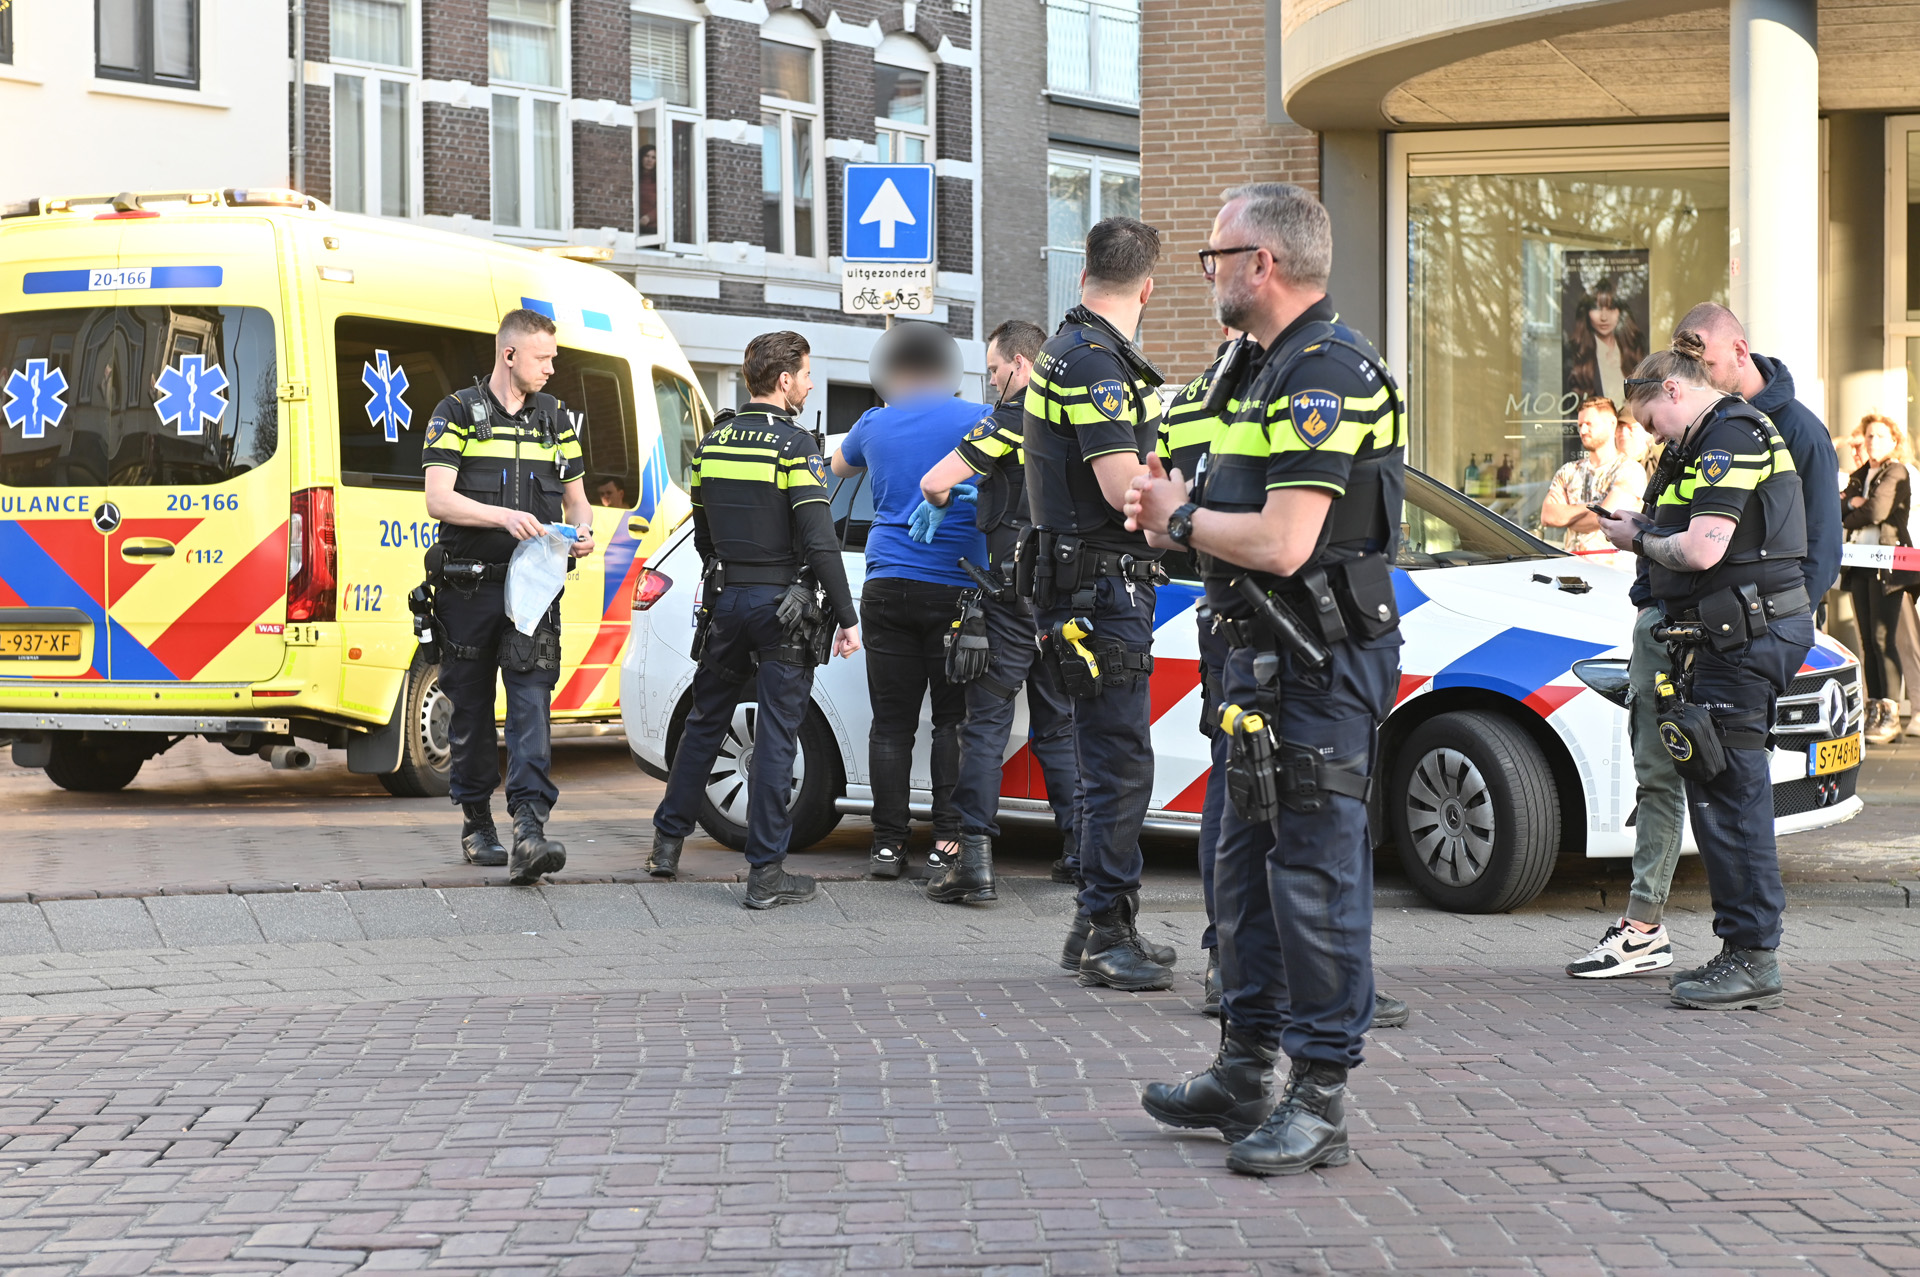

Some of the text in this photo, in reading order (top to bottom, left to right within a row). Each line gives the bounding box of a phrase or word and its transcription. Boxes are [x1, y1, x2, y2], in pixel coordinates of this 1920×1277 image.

[94, 271, 146, 286] 20-166
[847, 268, 926, 279] uitgezonderd
[1094, 384, 1121, 394] POLITIE
[1294, 397, 1337, 409] POLITIE
[712, 425, 776, 444] POLITIE
[166, 494, 239, 511] 20-166
[1871, 551, 1907, 562] POLITIE
[567, 571, 580, 580] ord
[259, 625, 280, 633] WAS
